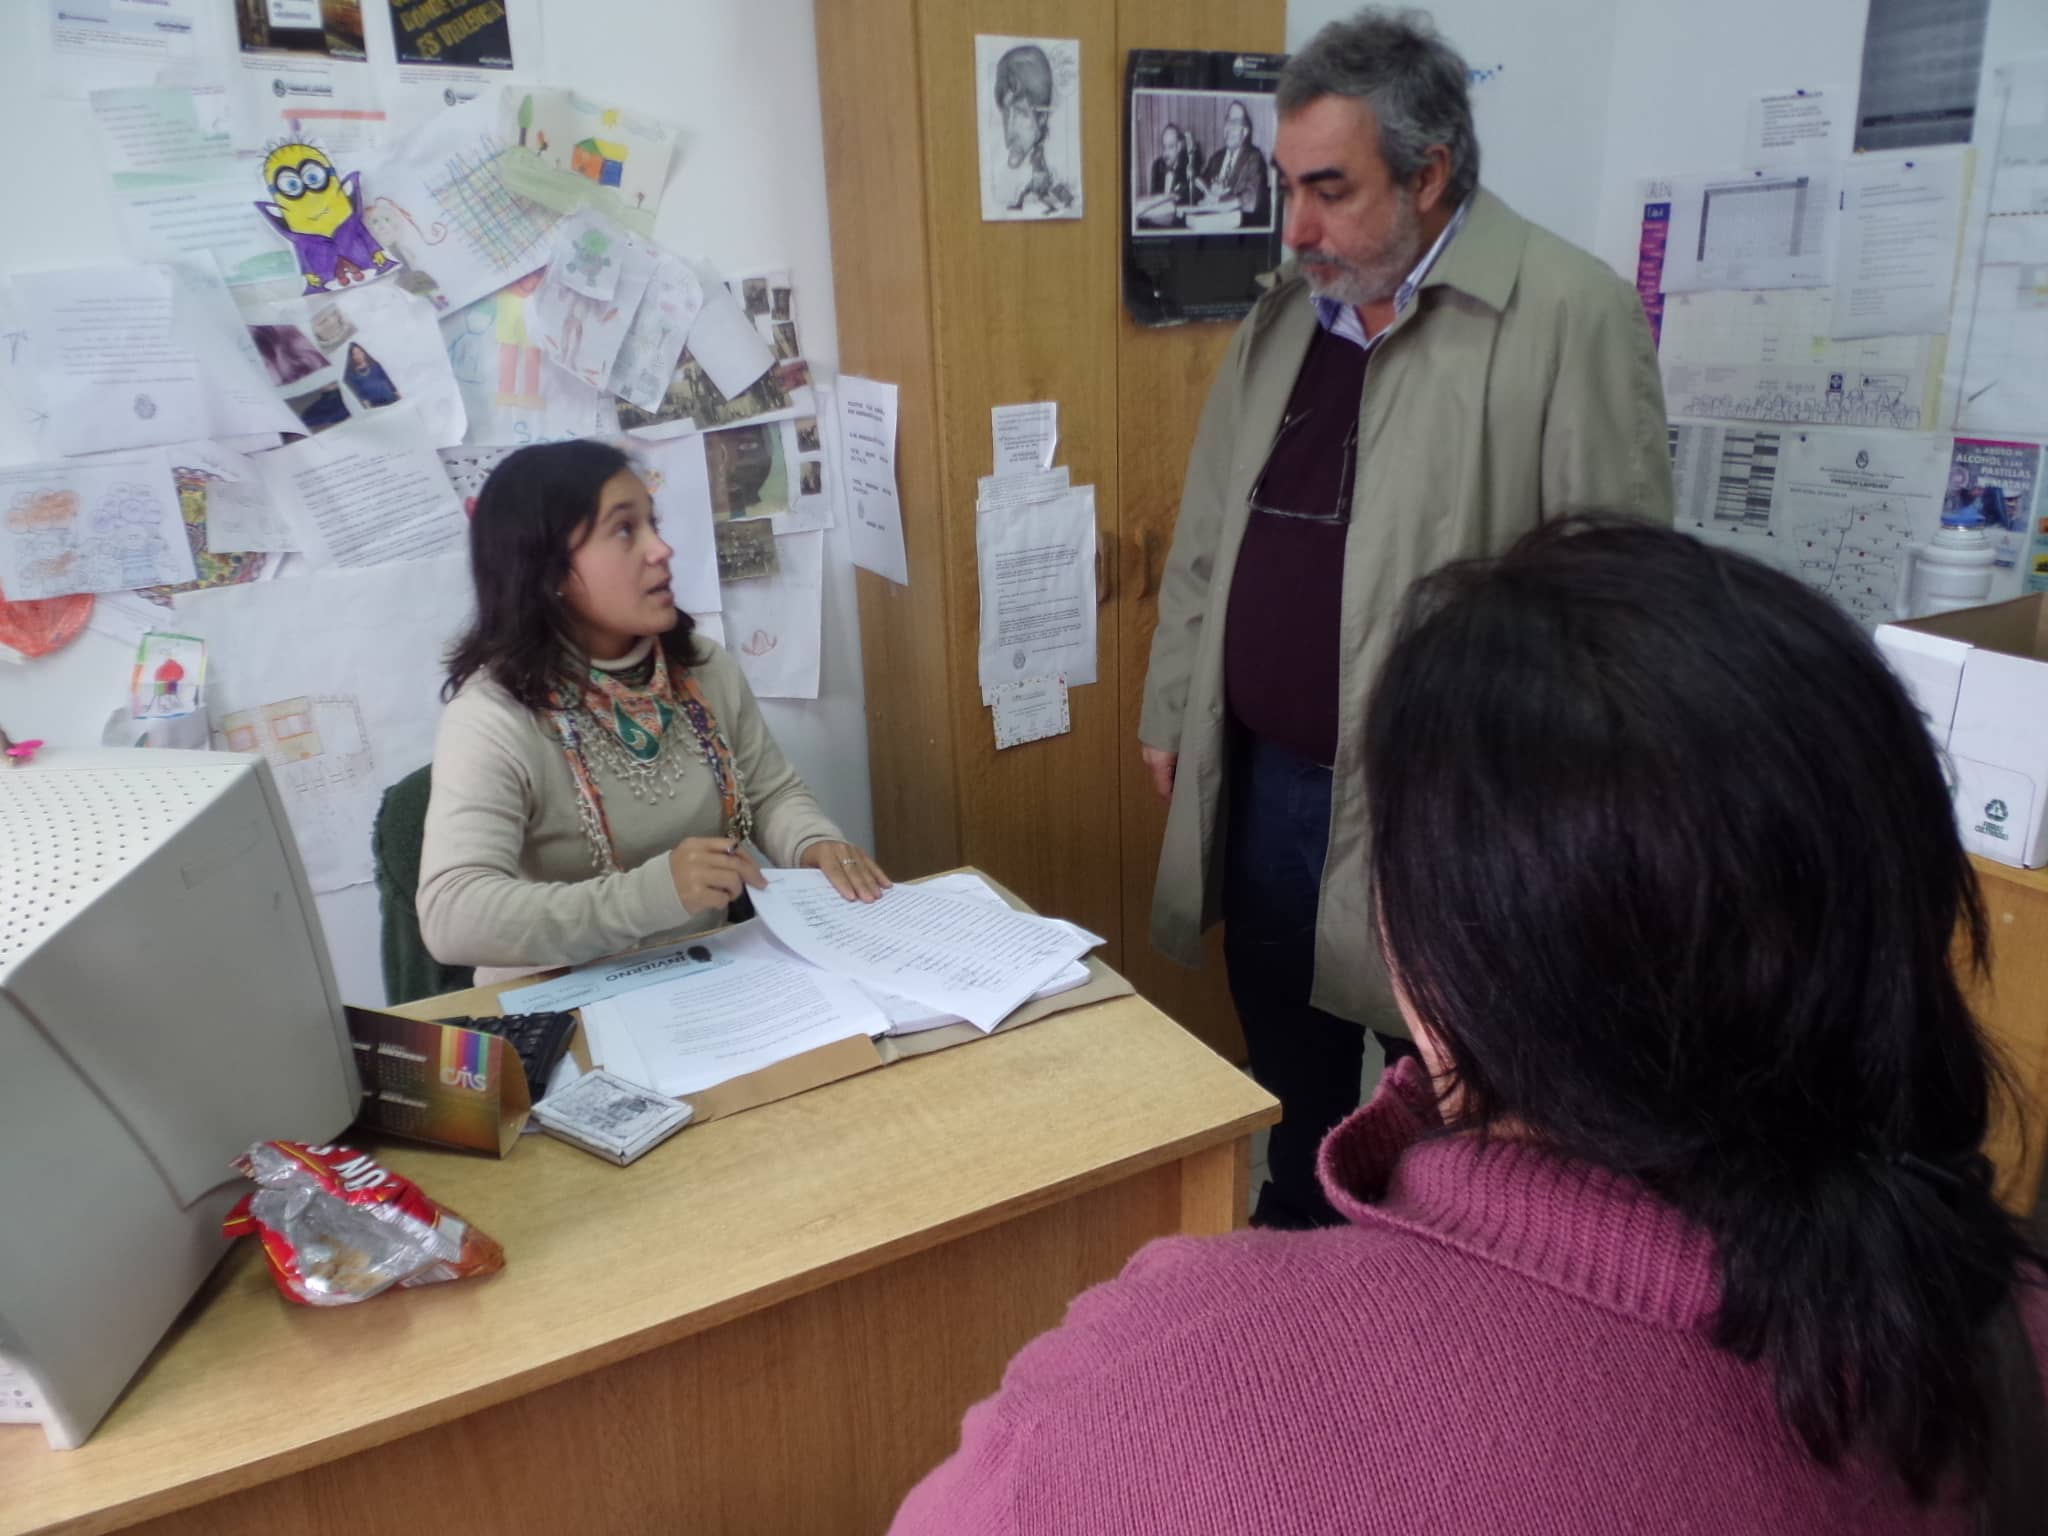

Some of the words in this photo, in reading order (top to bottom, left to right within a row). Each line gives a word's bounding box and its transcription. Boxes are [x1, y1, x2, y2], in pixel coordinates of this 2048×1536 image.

[1955, 454, 2001, 466] ALCOHOL
[1981, 467, 2031, 479] PASTILLAS
[605, 954, 687, 982] INVIERNO
